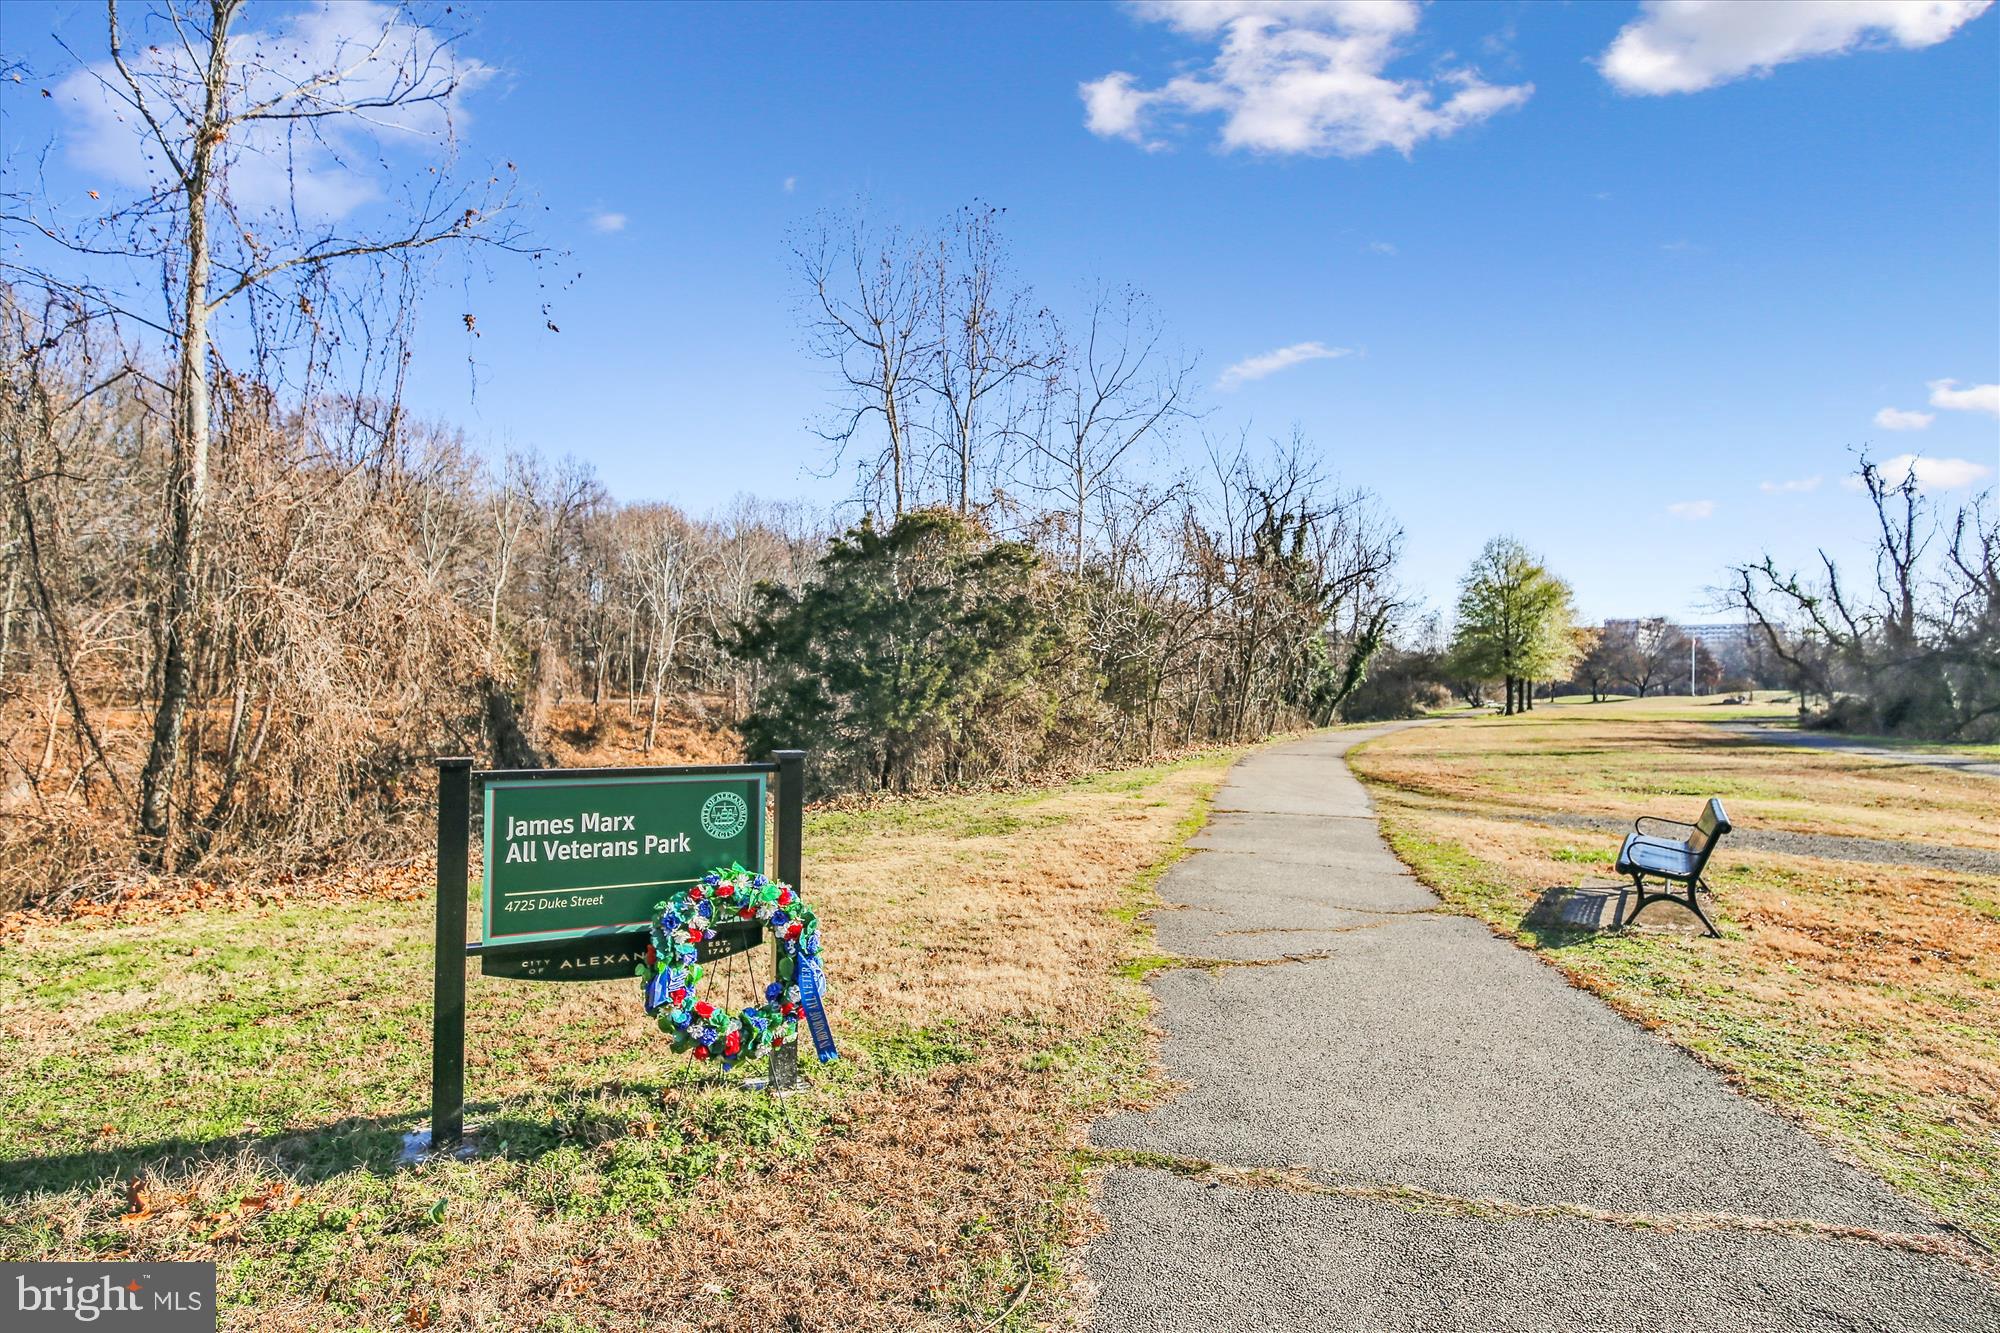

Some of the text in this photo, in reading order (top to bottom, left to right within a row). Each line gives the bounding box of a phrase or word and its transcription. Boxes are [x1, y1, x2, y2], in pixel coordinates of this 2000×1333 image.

[506, 812, 635, 841] James Marx
[505, 832, 691, 864] All Veterans Park
[504, 894, 604, 912] 4725 Duke Street
[708, 939, 731, 947] EST.
[708, 946, 731, 955] 1749
[521, 959, 550, 968] CITY
[559, 951, 680, 969] ALEXAN
[528, 967, 544, 975] OF
[805, 995, 820, 1010] ALL
